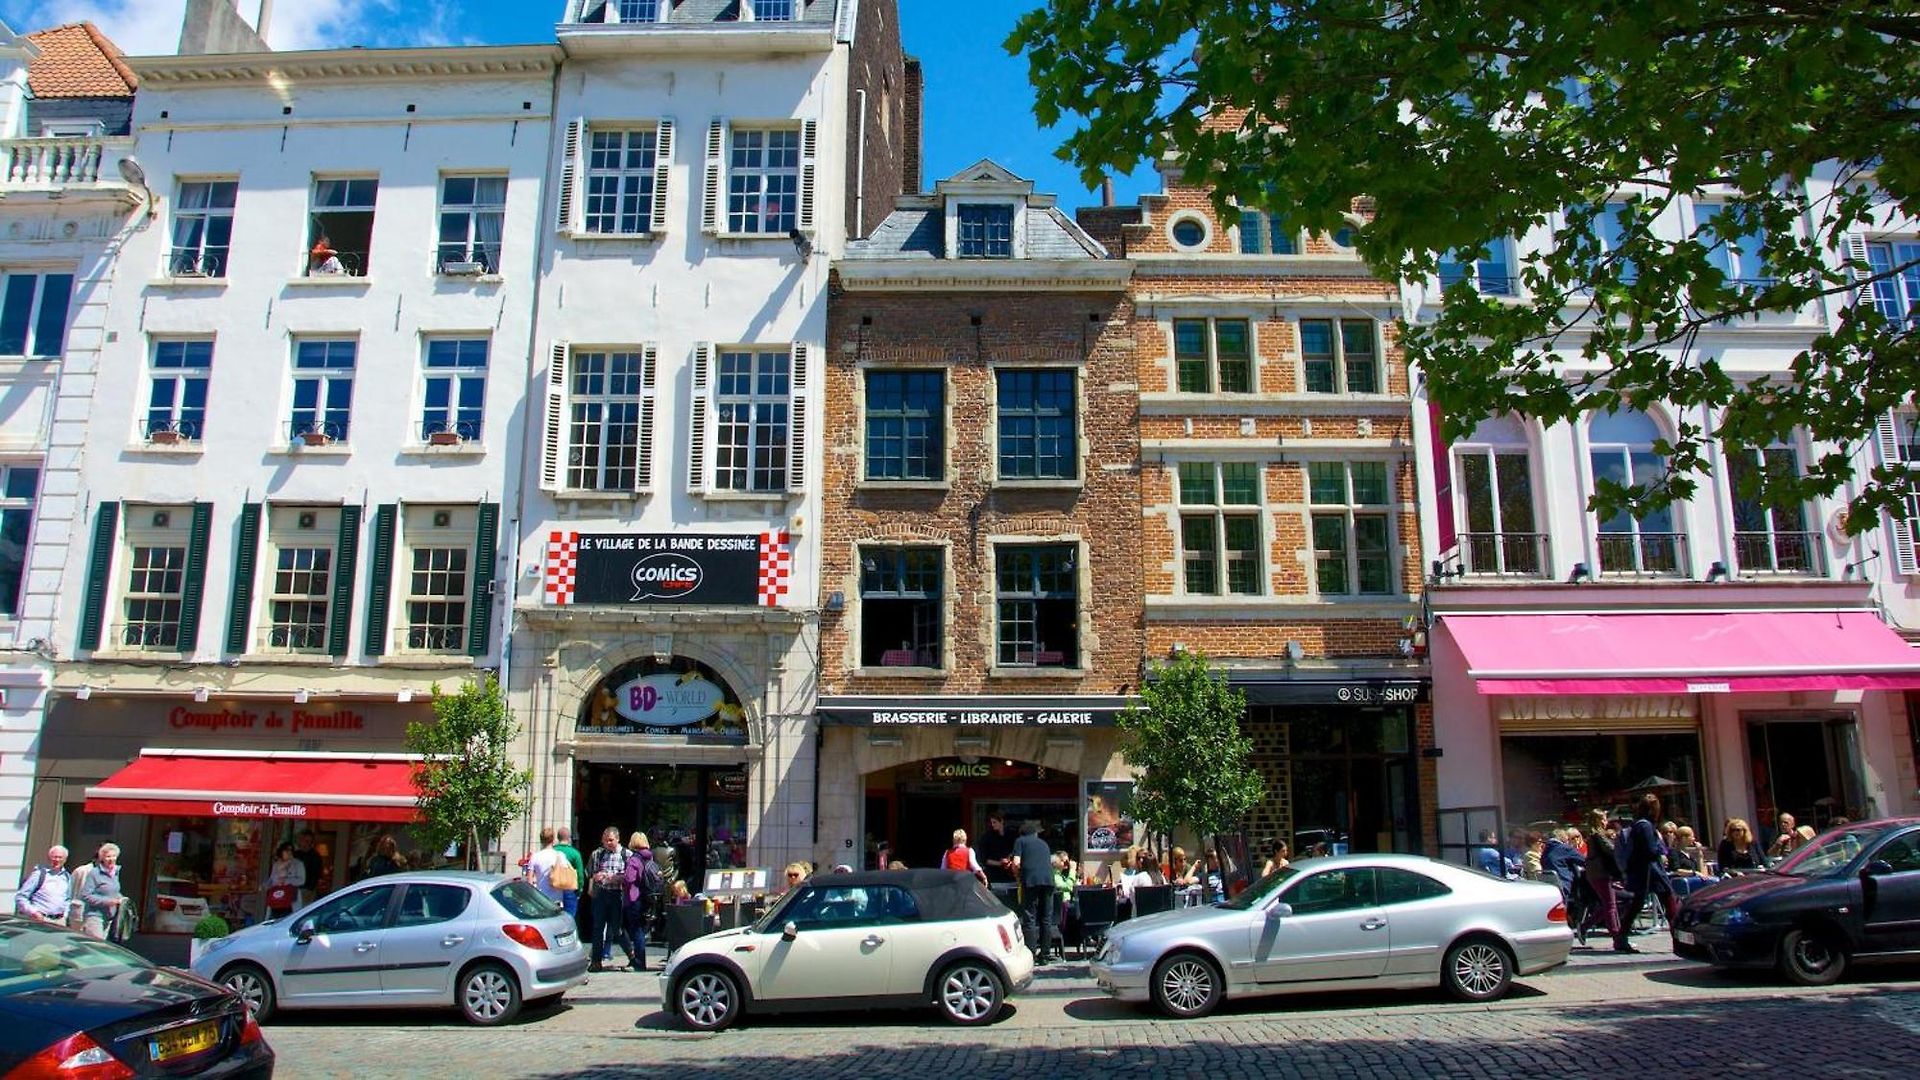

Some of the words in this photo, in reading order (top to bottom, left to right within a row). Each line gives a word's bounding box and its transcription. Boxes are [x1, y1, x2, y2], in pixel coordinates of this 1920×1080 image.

[580, 538, 591, 549] LE
[595, 538, 634, 549] VILLAGE
[639, 538, 651, 550] DE
[655, 538, 666, 550] LA
[670, 538, 704, 550] BANDE
[707, 536, 756, 550] DESSINÉE
[635, 564, 697, 581] COMICS
[1353, 687, 1384, 701] SUS
[1385, 687, 1418, 701] SHOP
[169, 706, 257, 731] Comptoir
[265, 711, 284, 728] de
[291, 710, 364, 733] Famille
[872, 712, 947, 724] BRASSERIE
[960, 713, 1024, 724] LIBRAIRIE
[1037, 713, 1092, 724] GALERIE
[937, 764, 990, 777] COMICS
[213, 802, 260, 815] Comptoir
[260, 804, 269, 814] de
[269, 803, 307, 817] Famille
[845, 839, 853, 848] 9
